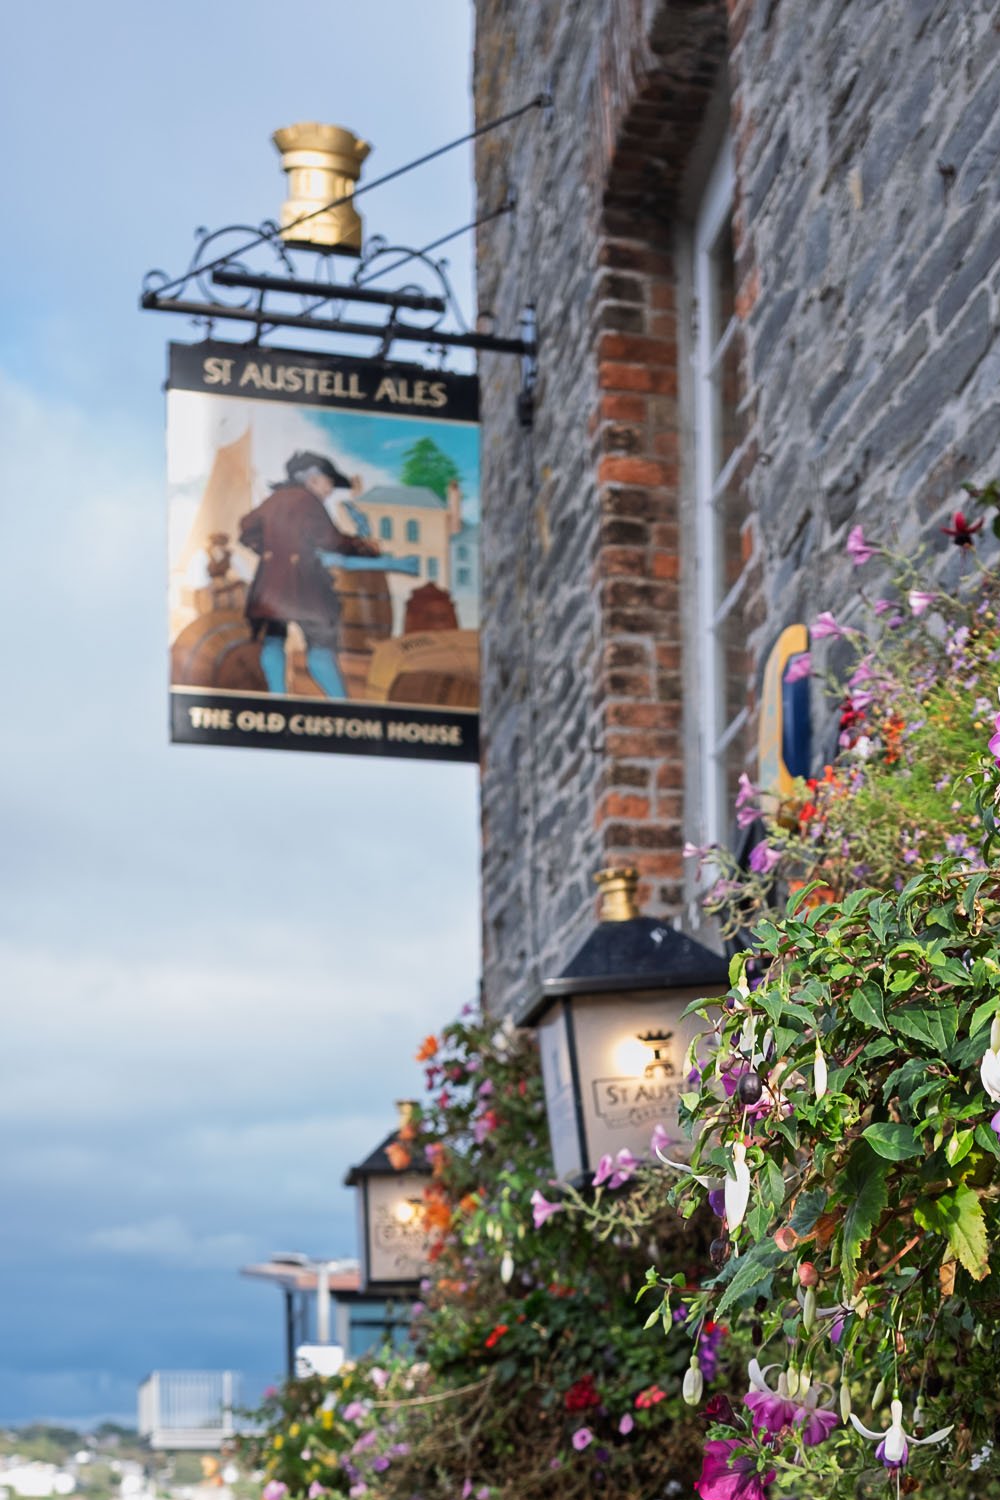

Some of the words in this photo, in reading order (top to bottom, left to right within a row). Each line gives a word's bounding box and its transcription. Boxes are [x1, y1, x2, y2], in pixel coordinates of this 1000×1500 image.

[203, 356, 235, 386] ST
[239, 361, 367, 400] AUSTELL
[373, 377, 448, 409] ALES
[189, 706, 233, 730] THE
[236, 710, 286, 733] OLD
[289, 714, 383, 740] CUSTOM
[387, 721, 463, 746] HOUSE
